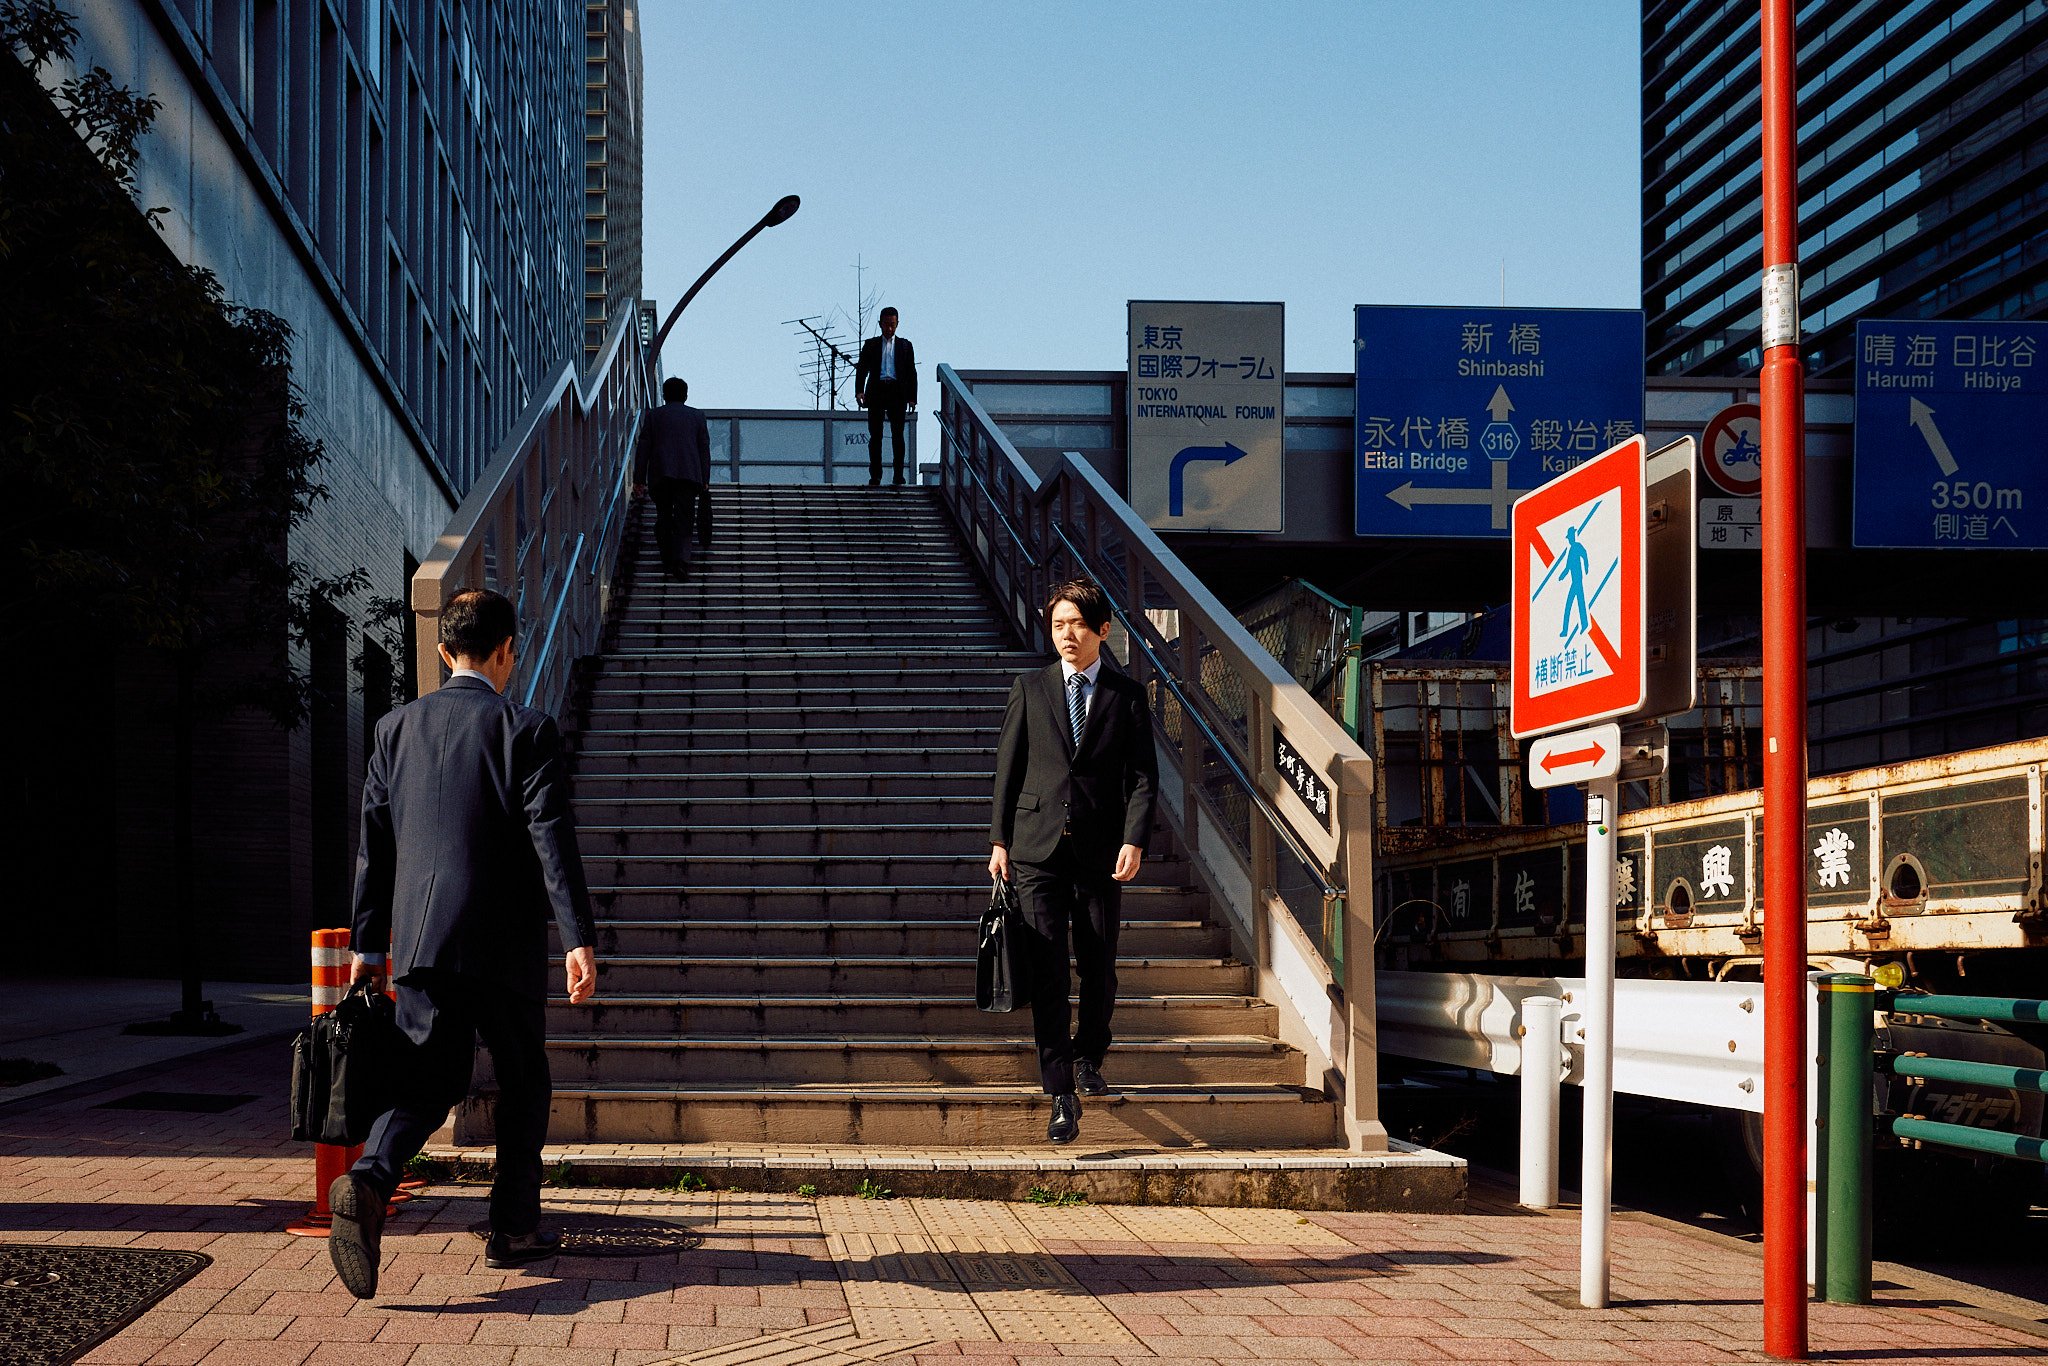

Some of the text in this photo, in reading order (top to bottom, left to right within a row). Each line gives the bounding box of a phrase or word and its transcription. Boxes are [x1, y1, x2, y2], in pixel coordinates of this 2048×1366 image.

[1138, 325, 1183, 350] 東京
[1461, 322, 1541, 355] 新橋
[1865, 335, 2037, 368] 晴海 日比谷
[1138, 355, 1275, 379] 国際フォーラム
[1458, 359, 1544, 377] Shinbashi
[1867, 371, 2022, 392] Harumi Hibiya
[1138, 387, 1178, 401] TOKYO
[1137, 405, 1275, 419] INTERNATIONAL FORUM
[1364, 417, 1636, 451] 永代橋 鍛冶橋
[1487, 433, 1513, 450] 316
[1364, 452, 1468, 473] Eitai Bridge
[1932, 482, 2023, 510] 350m
[1933, 514, 2018, 541] 側道へ
[1535, 644, 1594, 688] 横断禁止
